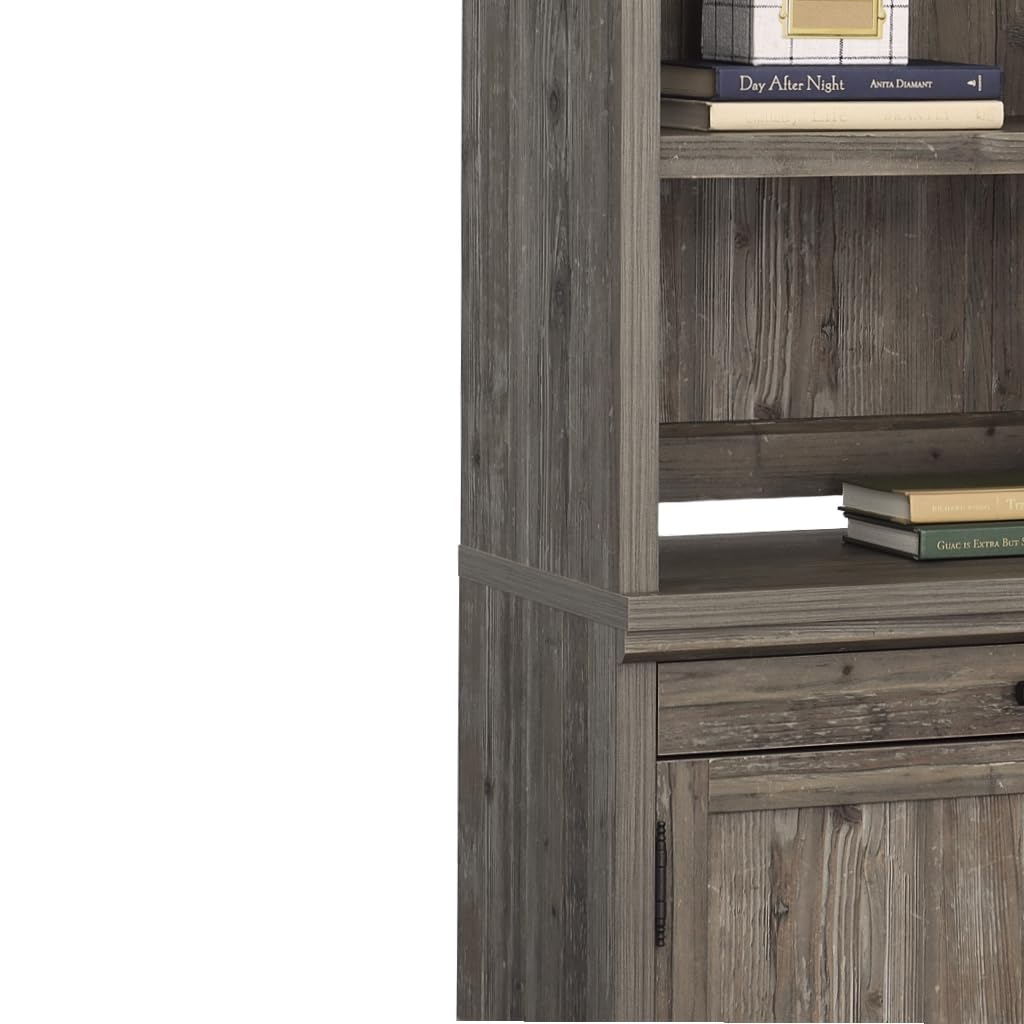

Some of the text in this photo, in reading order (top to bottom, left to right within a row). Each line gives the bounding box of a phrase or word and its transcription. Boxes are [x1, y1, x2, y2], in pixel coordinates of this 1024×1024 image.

[739, 74, 845, 93] Day After Night
[870, 79, 933, 88] ANITA DIAMANT
[937, 540, 961, 551] GUAC
[973, 538, 1000, 549] EXTRA
[1002, 537, 1020, 547] BUT
